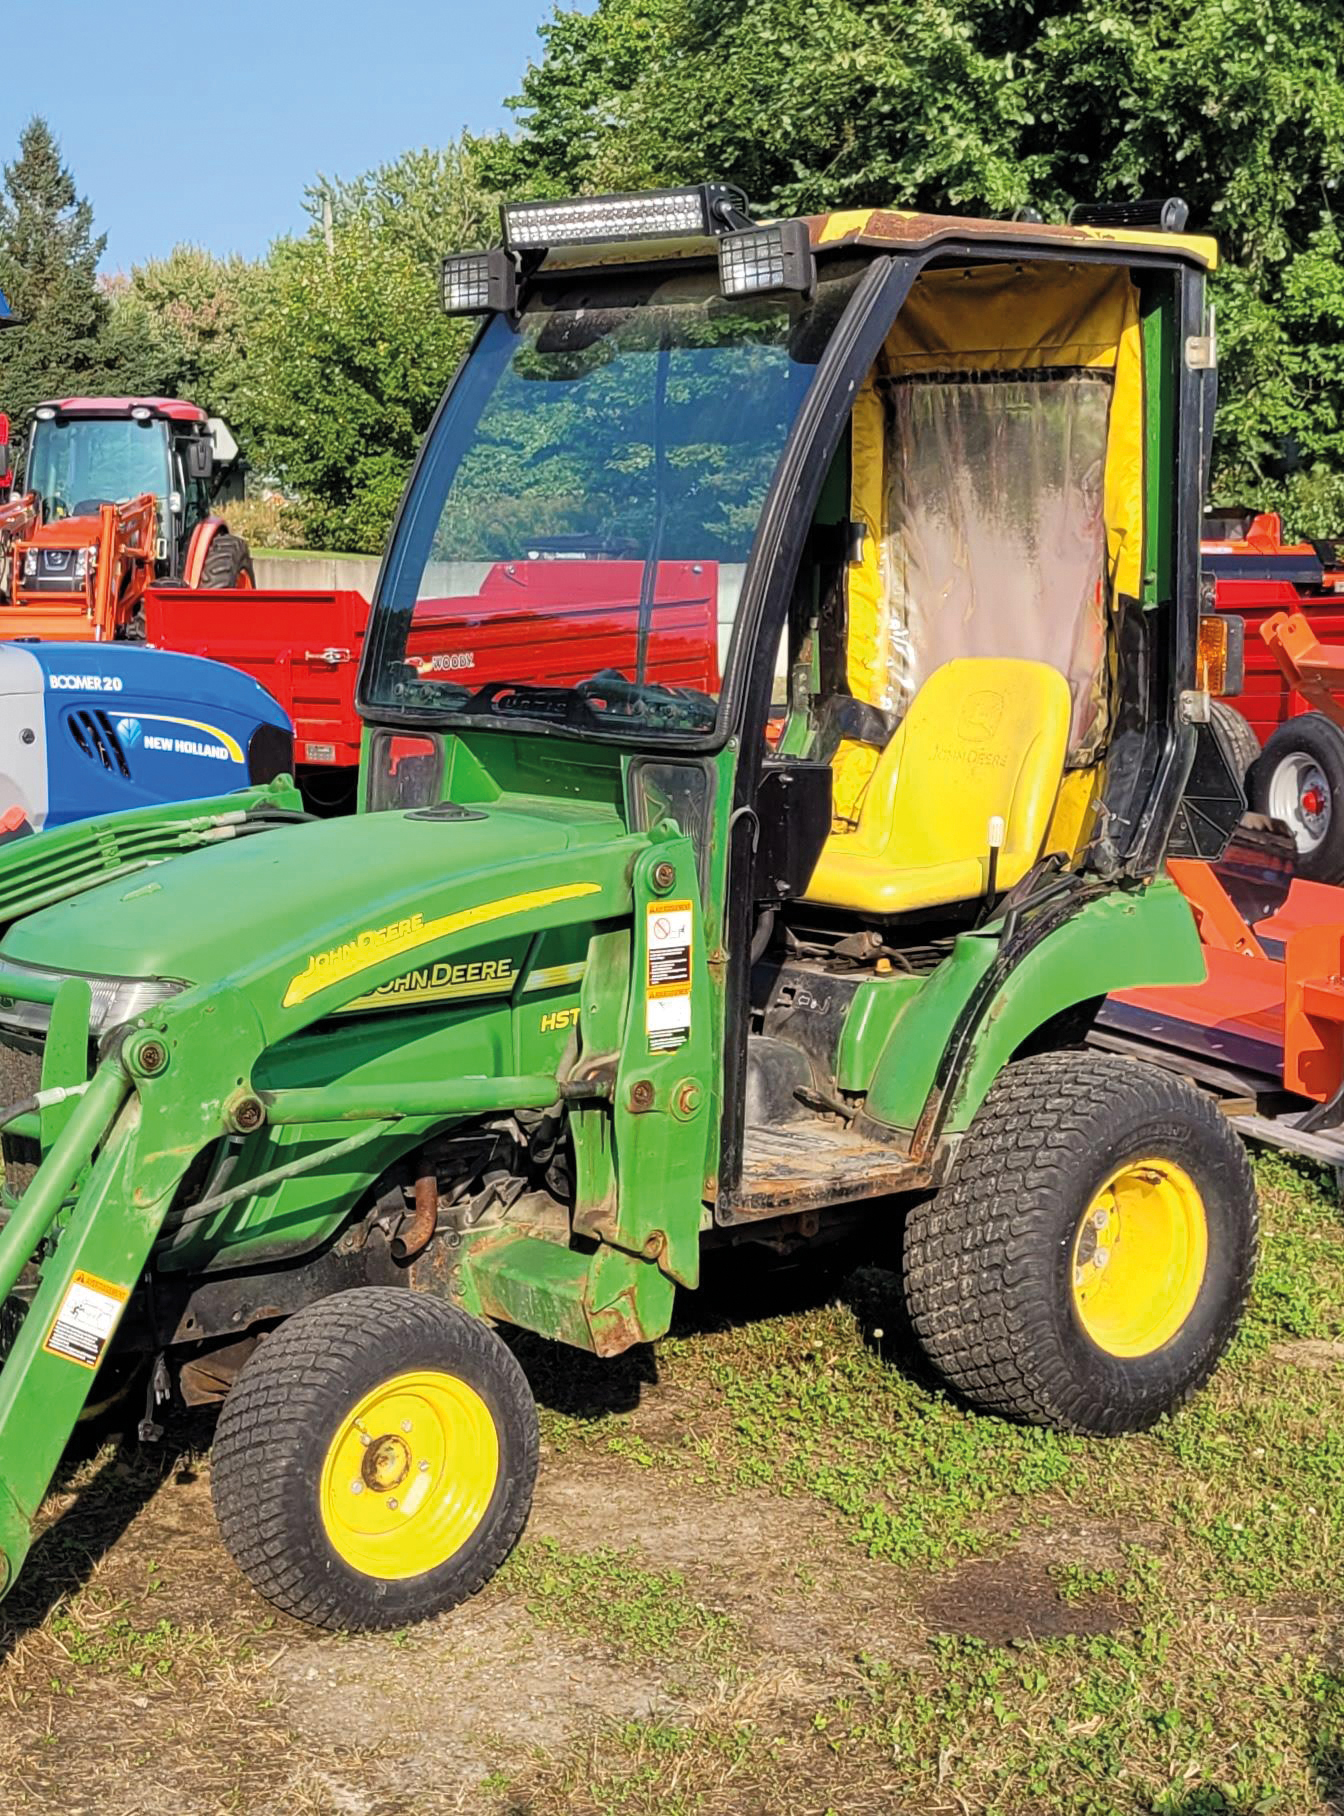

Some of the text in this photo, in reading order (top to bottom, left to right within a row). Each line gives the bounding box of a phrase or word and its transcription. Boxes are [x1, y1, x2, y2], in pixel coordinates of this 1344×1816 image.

[49, 675, 123, 691] BOOMER 20
[144, 736, 228, 760] NEW HOLLAND
[302, 912, 424, 977] JOHN DEERE
[373, 959, 513, 996] HN DEERE
